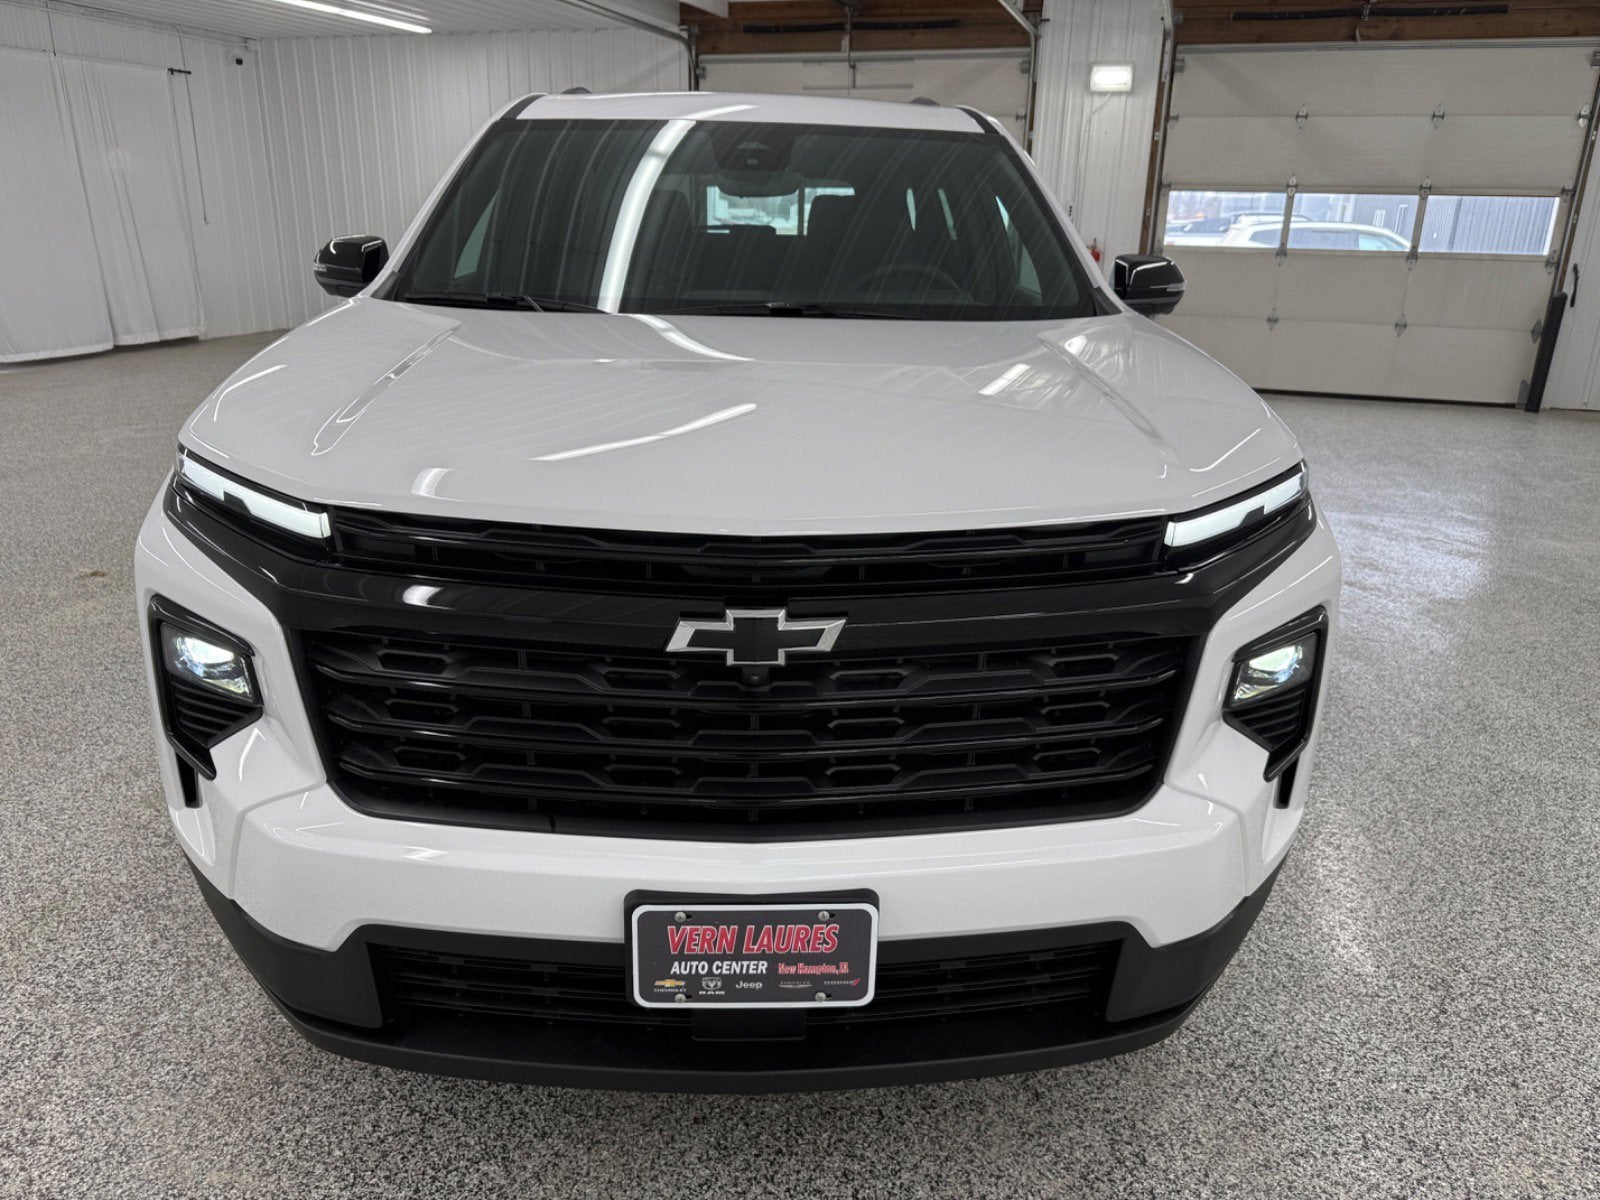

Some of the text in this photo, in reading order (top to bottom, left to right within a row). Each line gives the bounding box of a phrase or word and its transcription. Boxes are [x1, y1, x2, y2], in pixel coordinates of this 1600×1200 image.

[667, 924, 840, 954] VERN LAURES
[670, 960, 768, 975] AUTO CENTER
[777, 962, 796, 974] New
[735, 980, 763, 990] Jeep
